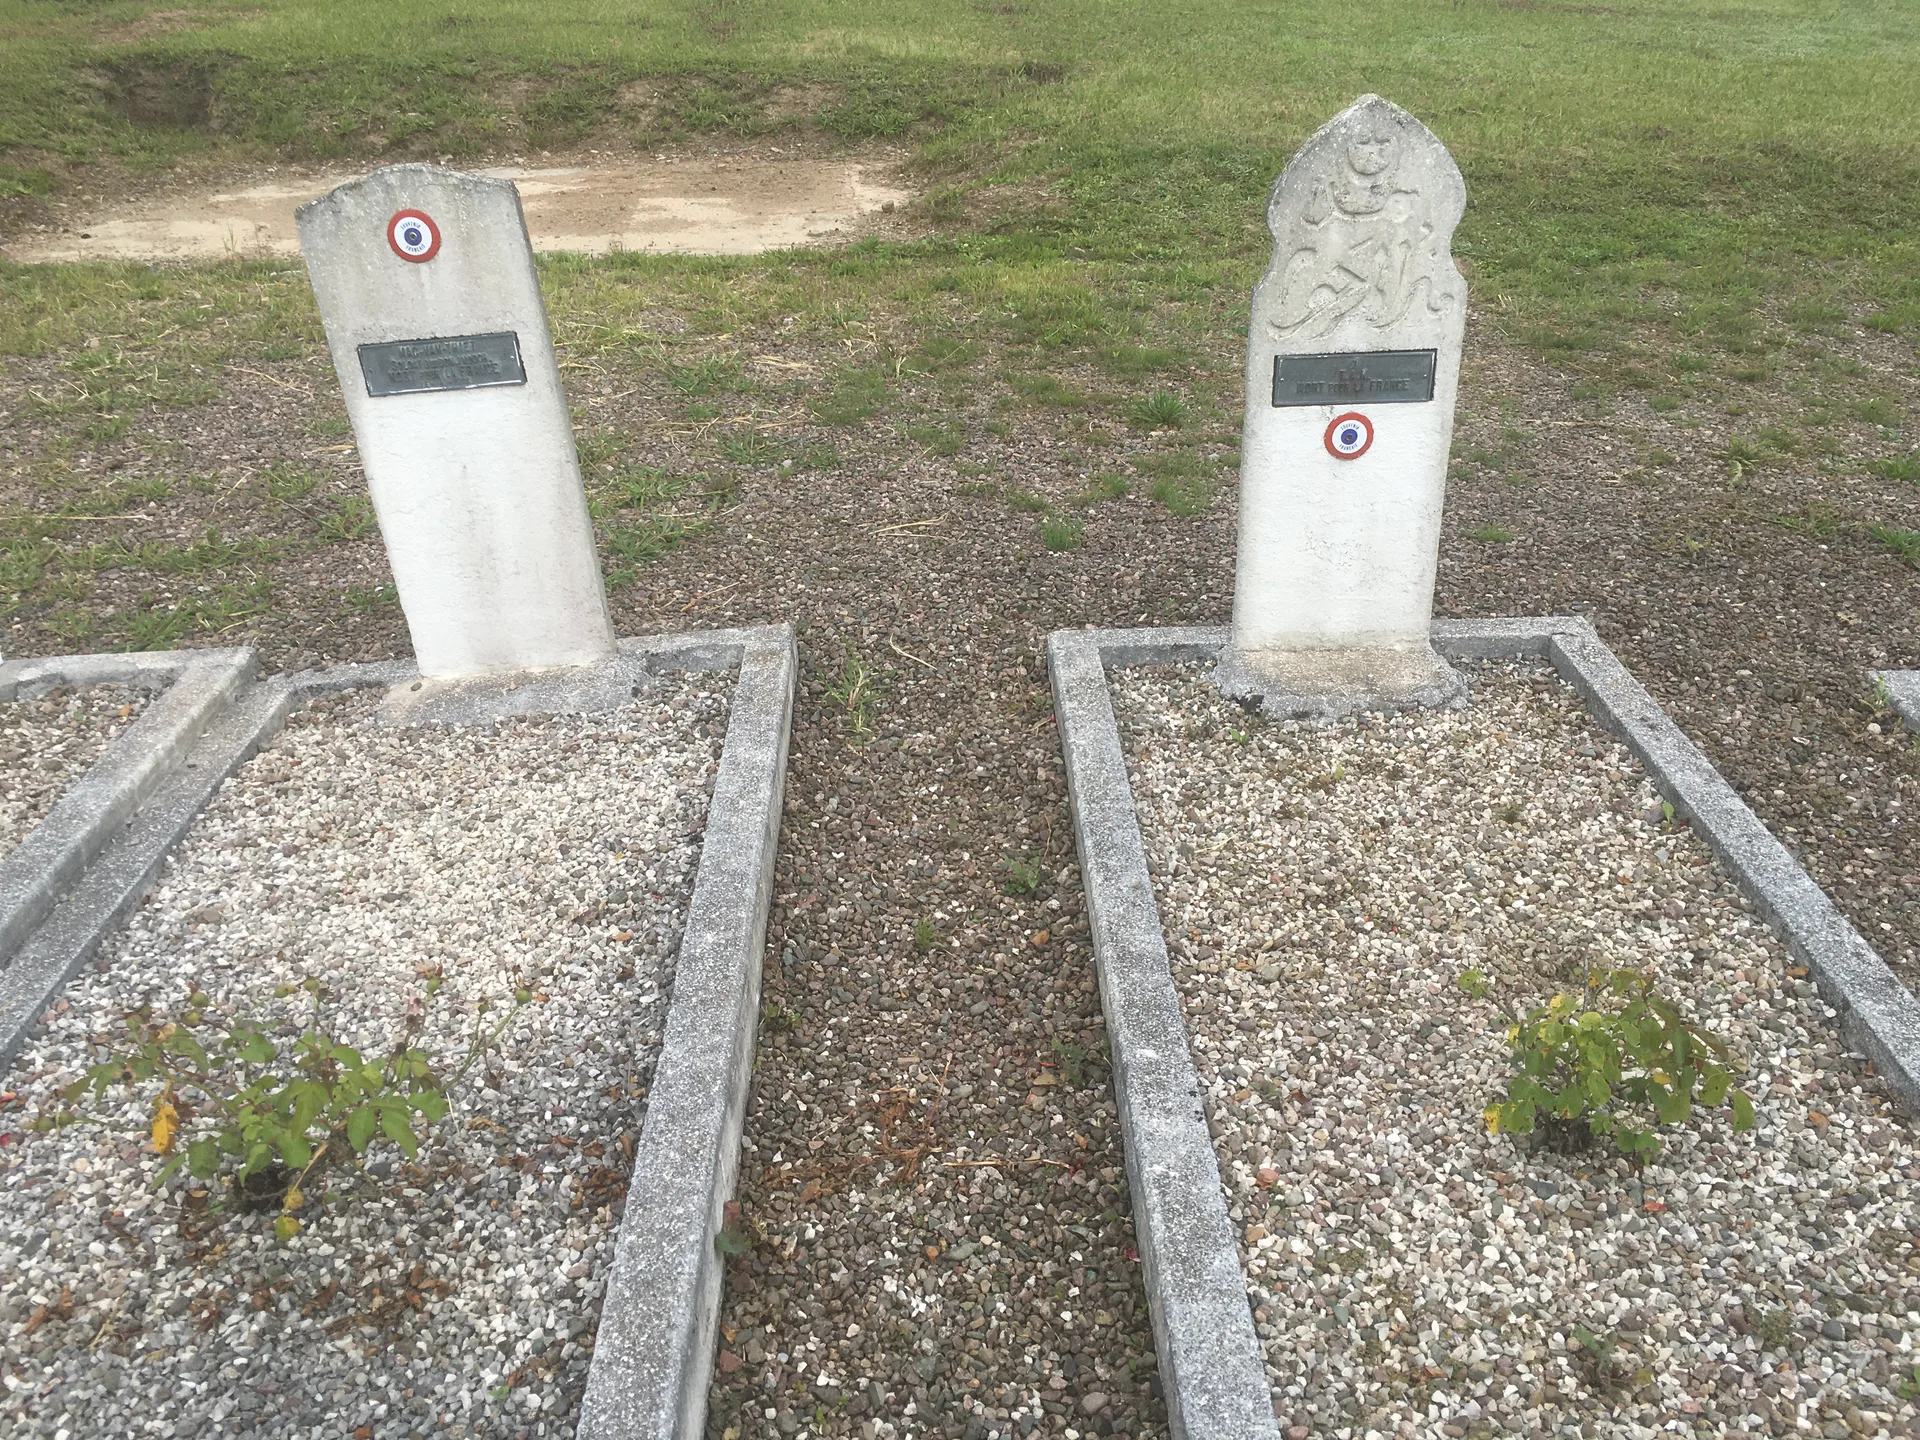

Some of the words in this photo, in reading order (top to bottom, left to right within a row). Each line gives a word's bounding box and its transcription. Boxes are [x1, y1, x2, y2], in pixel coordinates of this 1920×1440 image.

[1297, 381, 1325, 393] MORT
[1328, 382, 1349, 393] POUR
[1353, 381, 1365, 392] LA
[1370, 378, 1410, 392] FRANCE
[1340, 423, 1360, 431] SOUVENIR
